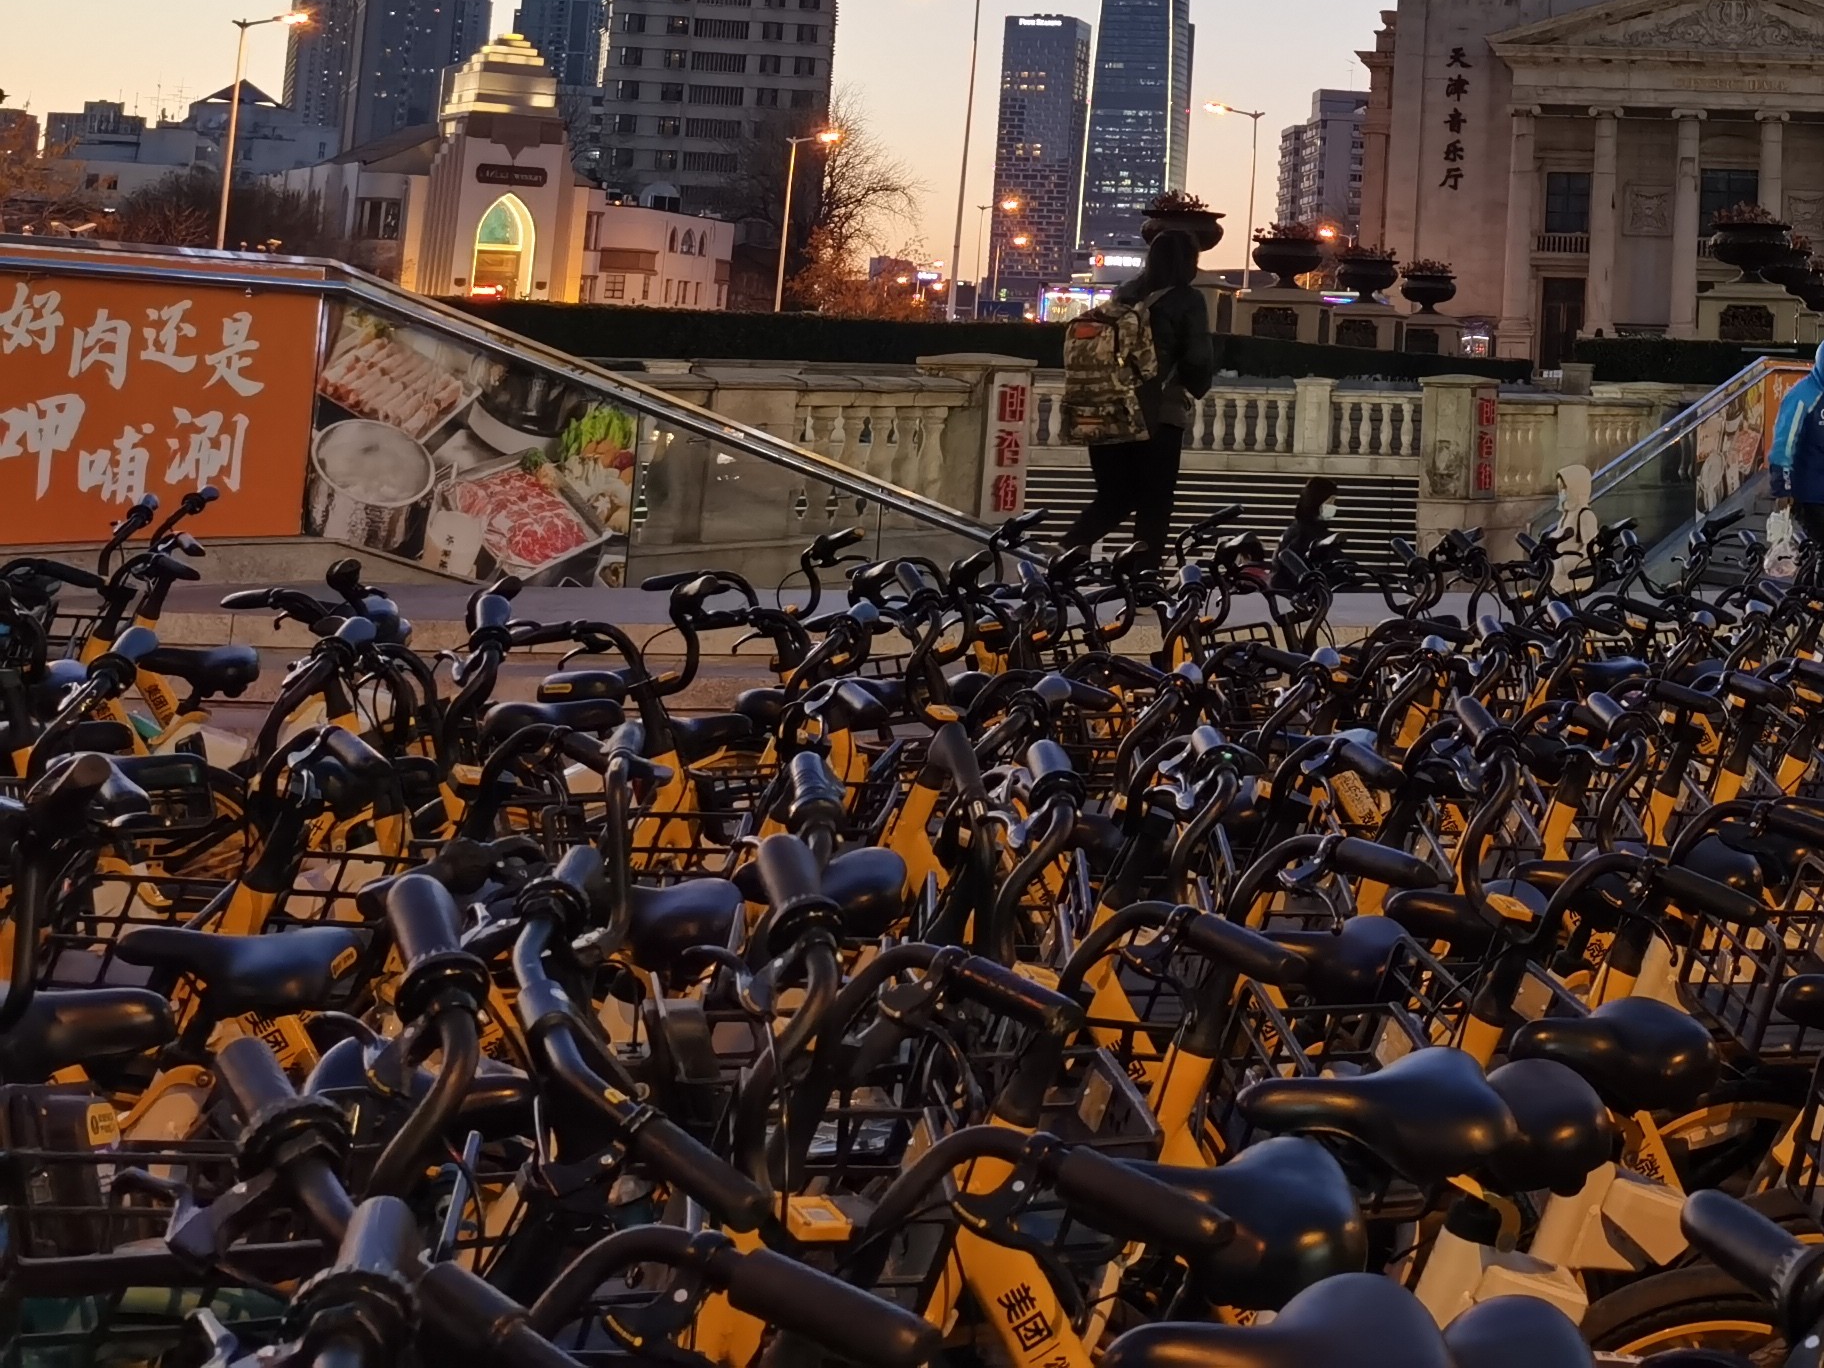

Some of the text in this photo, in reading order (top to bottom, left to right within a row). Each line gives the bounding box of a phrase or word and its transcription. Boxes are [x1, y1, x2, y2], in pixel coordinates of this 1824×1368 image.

[1439, 46, 1473, 191] 天津音乐厅
[0, 281, 265, 397] 好肉还是
[0, 393, 250, 506] 呷哺涮
[996, 1282, 1054, 1352] 美团
